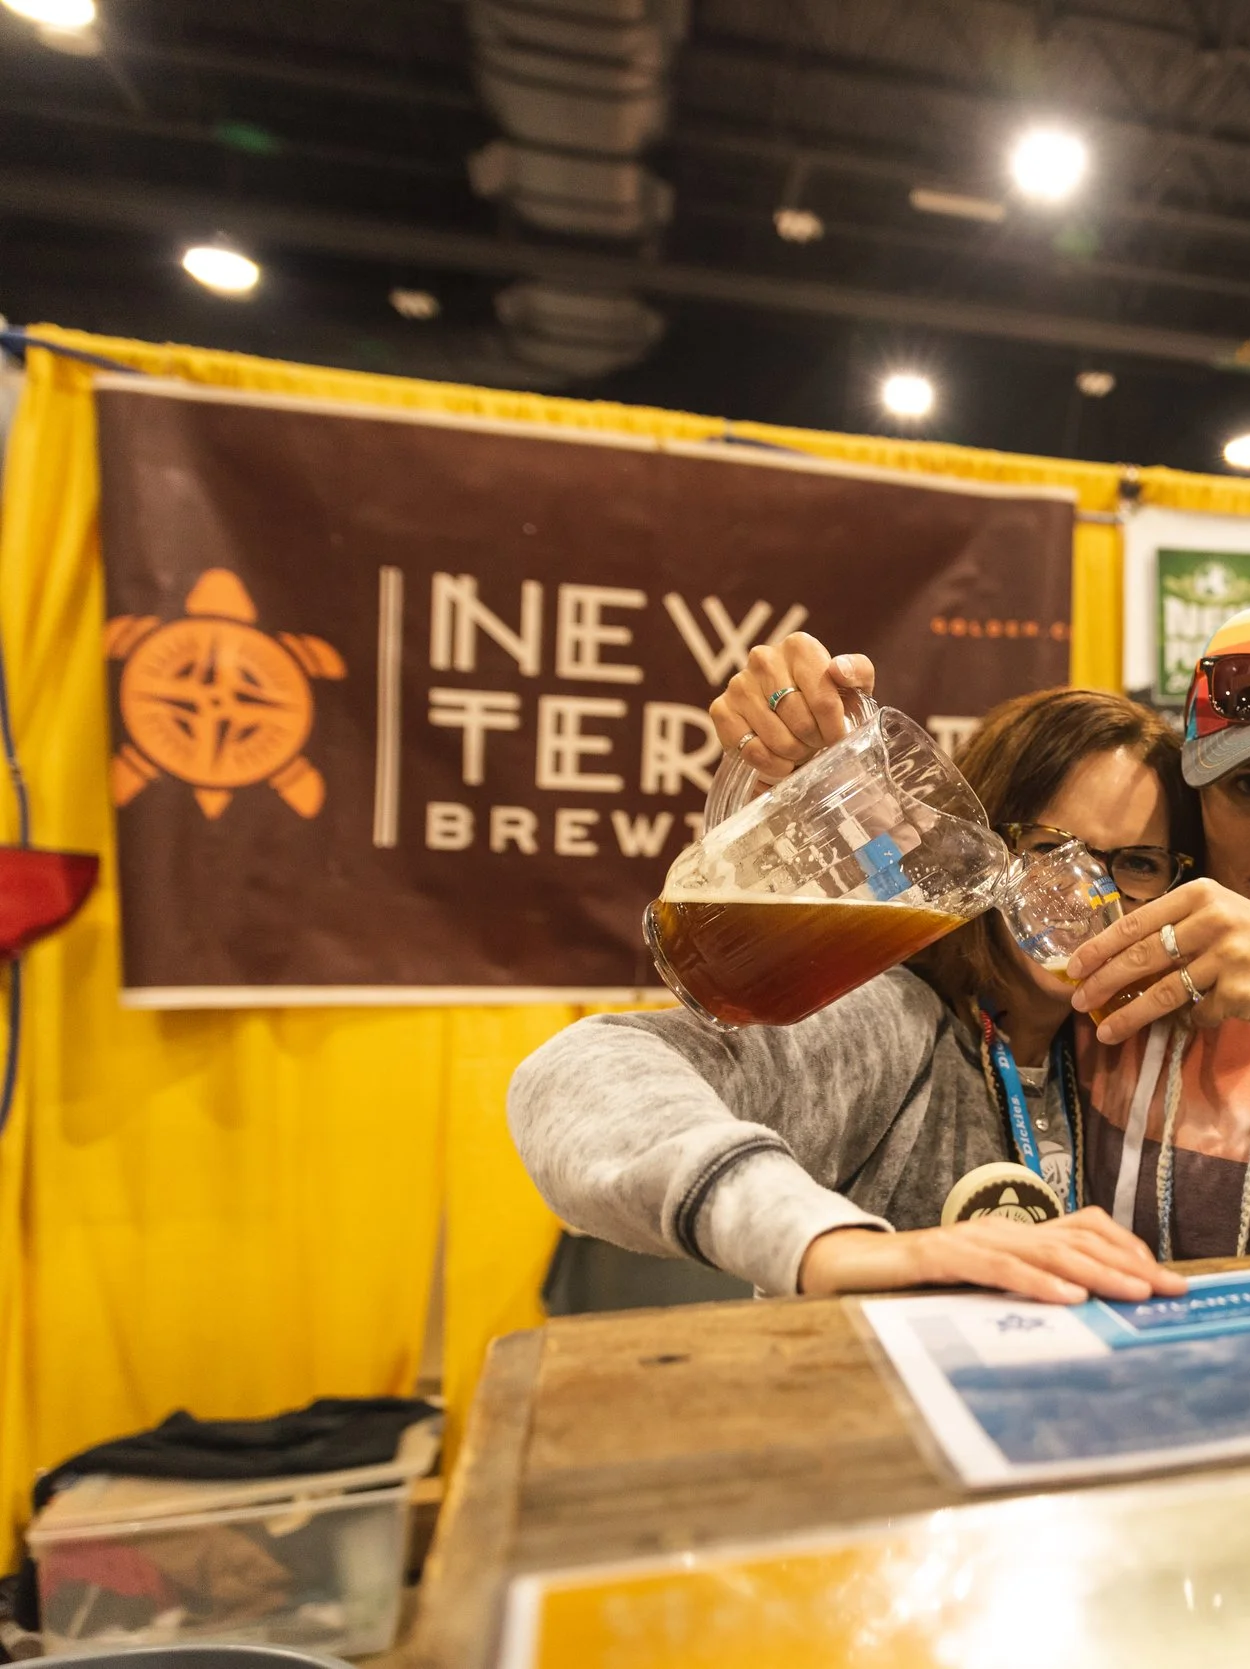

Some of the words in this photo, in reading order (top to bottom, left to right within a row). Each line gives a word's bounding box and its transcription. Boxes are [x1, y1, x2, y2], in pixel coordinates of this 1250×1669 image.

[430, 572, 808, 686] NEW
[425, 801, 706, 858] BREW
[1011, 1095, 1034, 1157] Dickies
